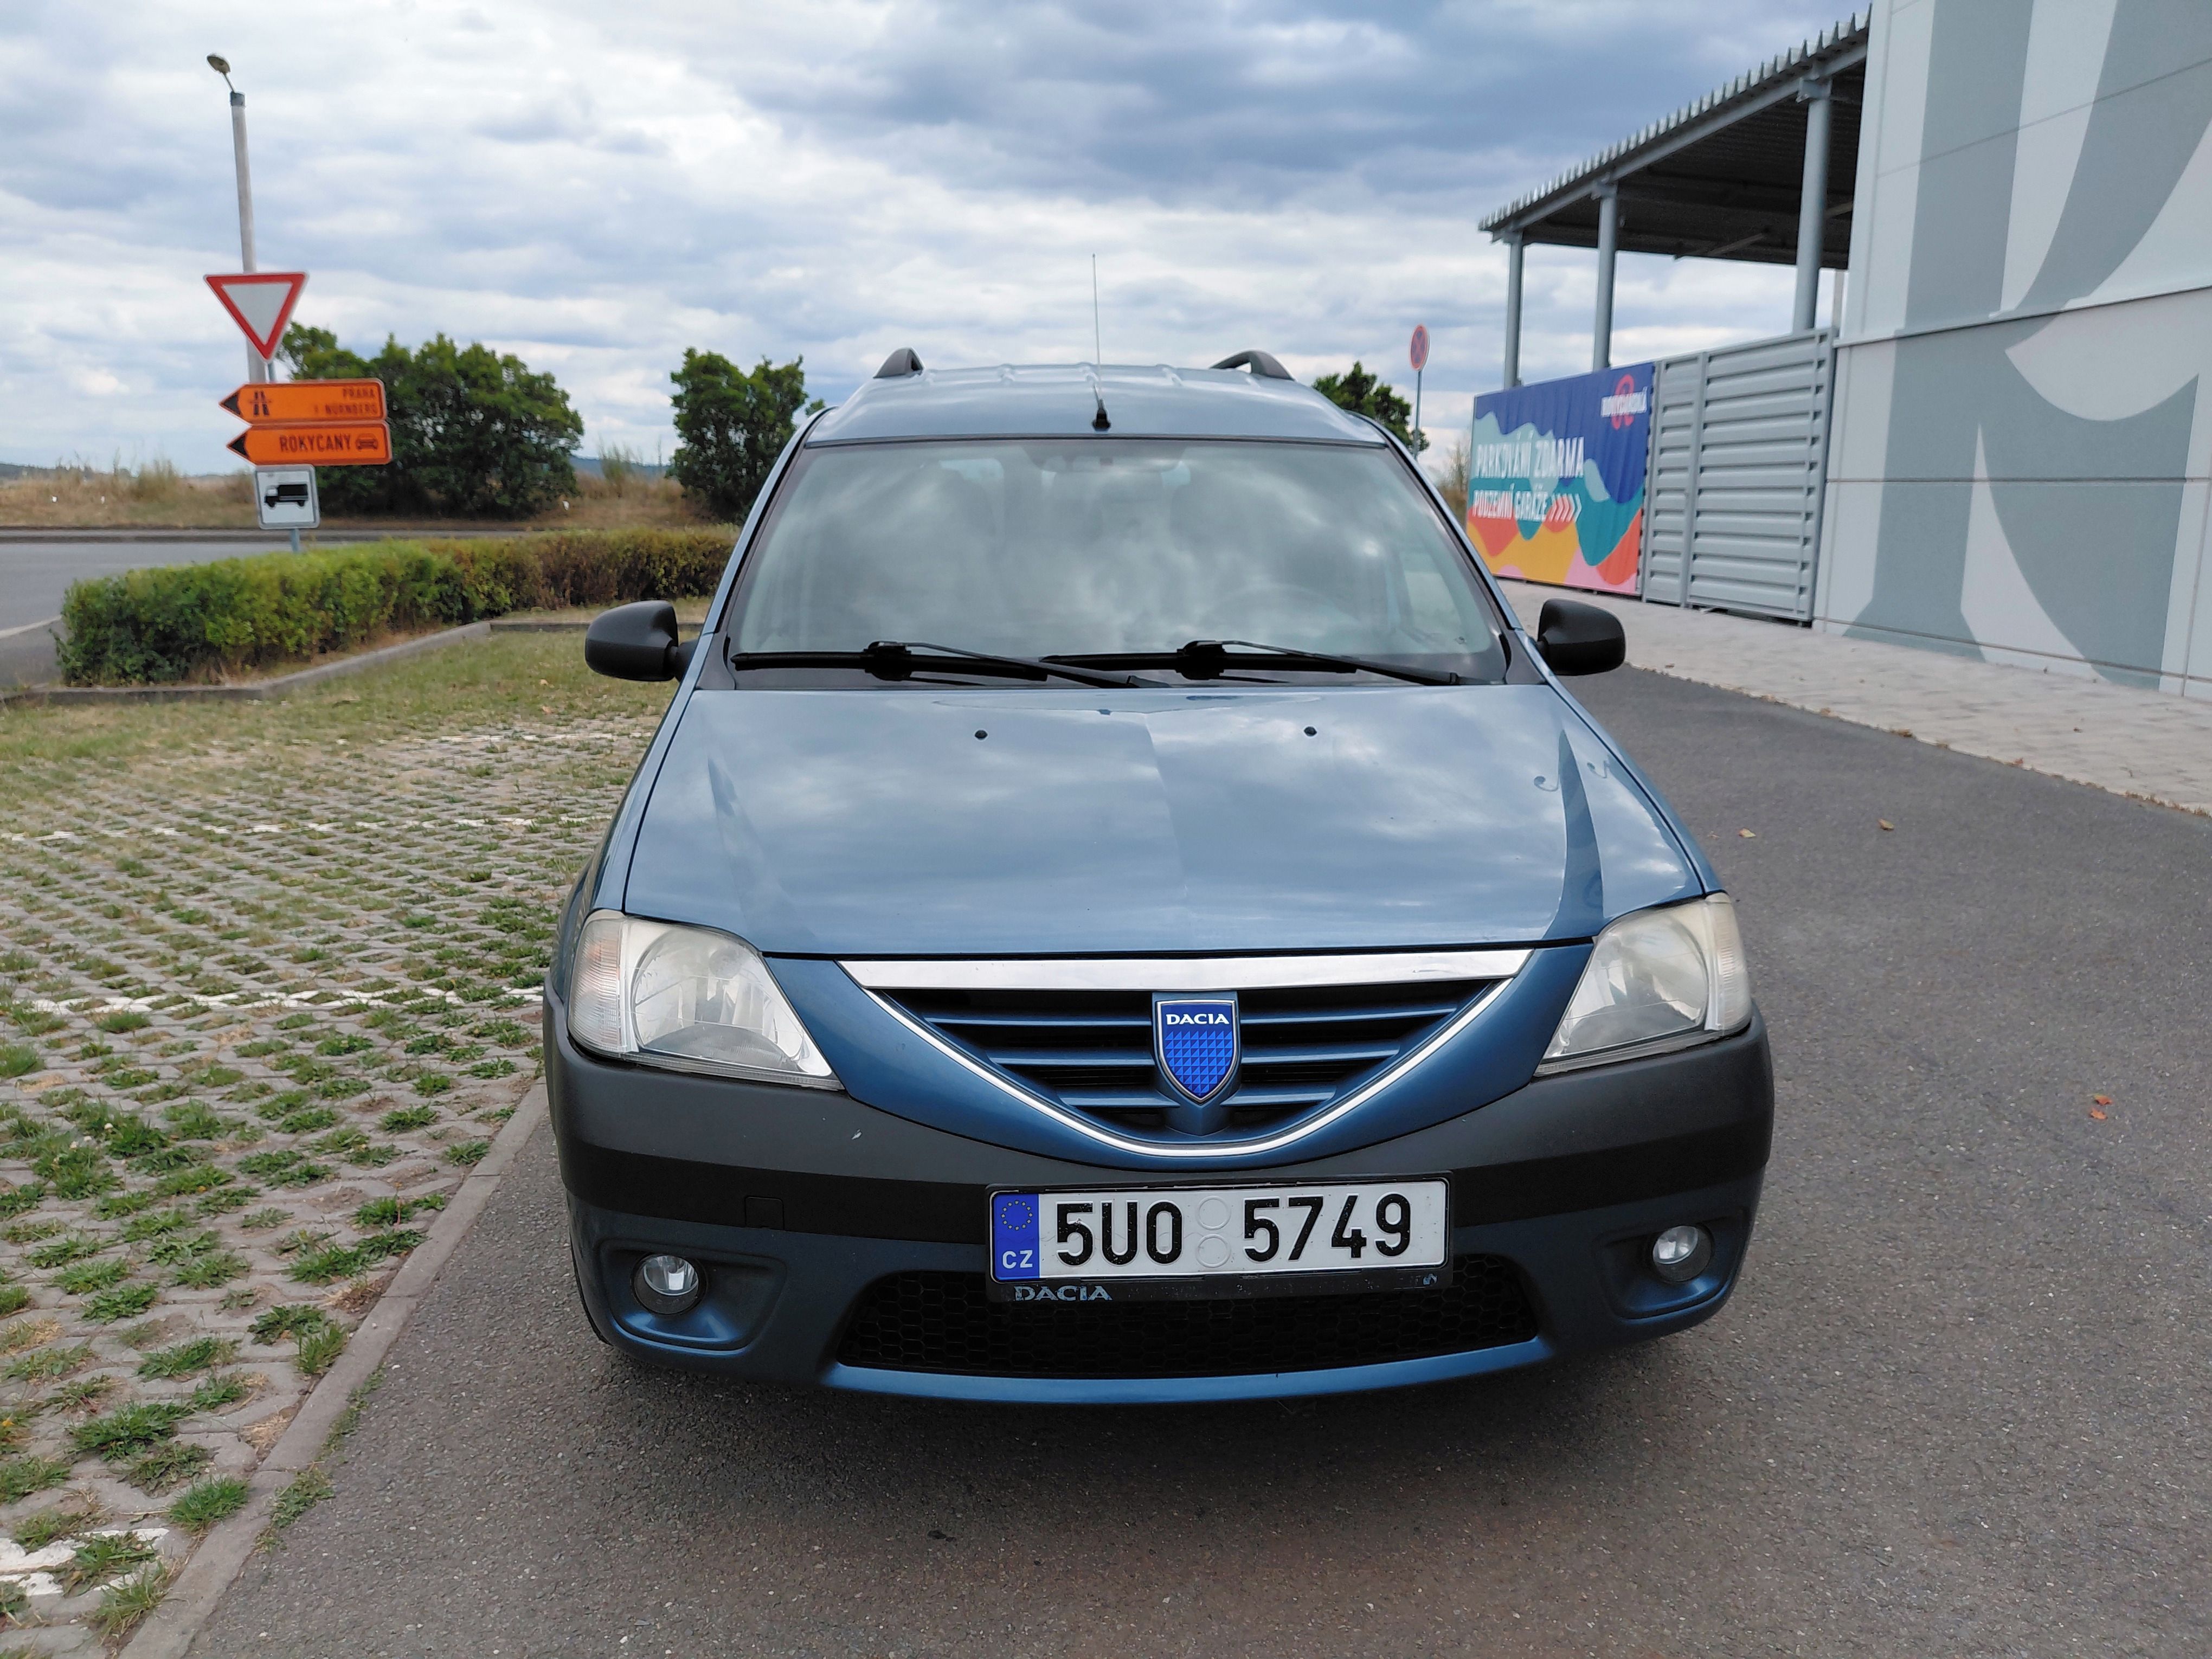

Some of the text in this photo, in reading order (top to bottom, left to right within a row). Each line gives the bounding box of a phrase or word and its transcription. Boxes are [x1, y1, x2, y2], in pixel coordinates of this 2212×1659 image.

[279, 434, 351, 452] ROKYCANY
[1166, 1013, 1230, 1025] DACIA
[1244, 1192, 1411, 1263] 5749
[1002, 1249, 1033, 1269] CZ
[1013, 1285, 1114, 1302] DACIA
